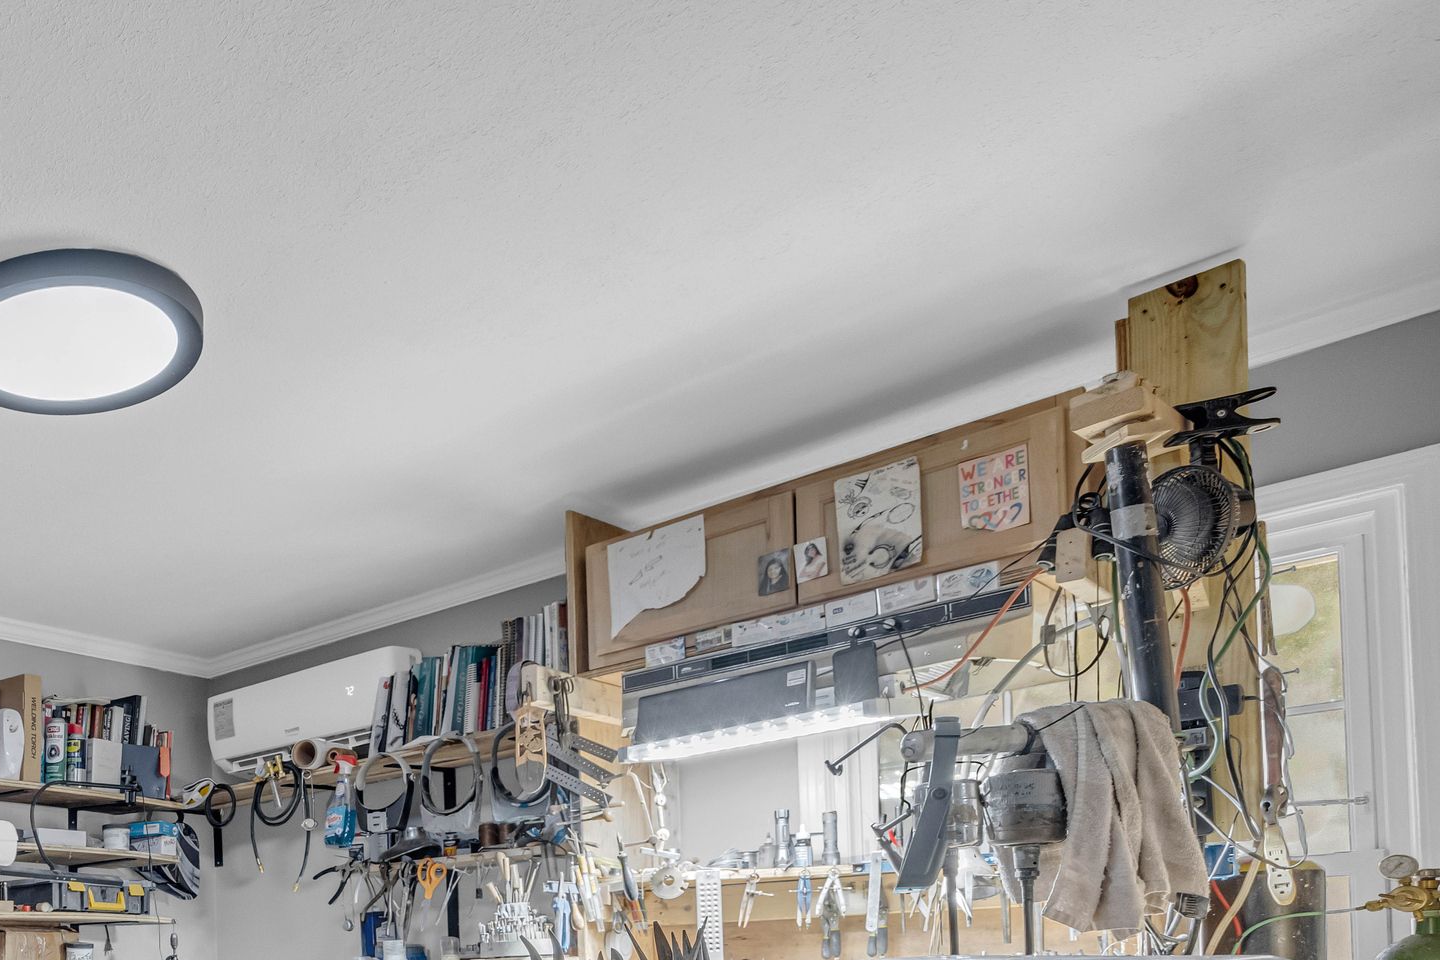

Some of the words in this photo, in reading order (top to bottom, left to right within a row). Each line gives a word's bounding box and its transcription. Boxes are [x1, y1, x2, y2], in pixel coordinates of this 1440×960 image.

[961, 461, 987, 481] WE
[992, 449, 1025, 473] ARE
[962, 469, 1026, 498] STRONGER
[963, 485, 1027, 514] TOGETHER
